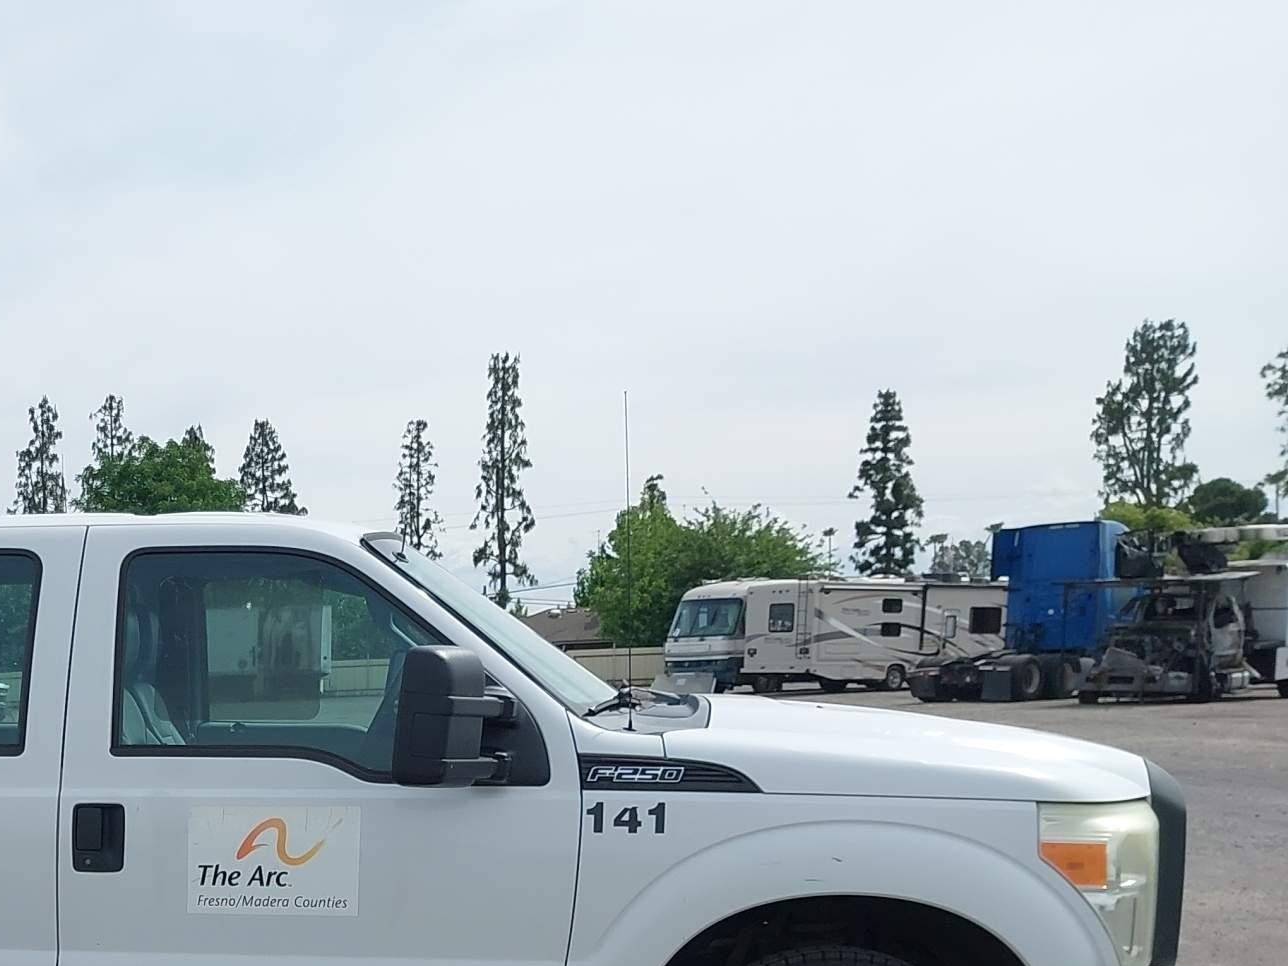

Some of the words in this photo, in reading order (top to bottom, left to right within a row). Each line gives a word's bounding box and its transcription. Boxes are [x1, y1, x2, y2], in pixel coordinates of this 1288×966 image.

[586, 766, 685, 783] F-250
[586, 801, 666, 834] 141
[198, 864, 241, 887] The
[197, 895, 289, 908] Fresno/Madera
[294, 896, 348, 909] Counties
